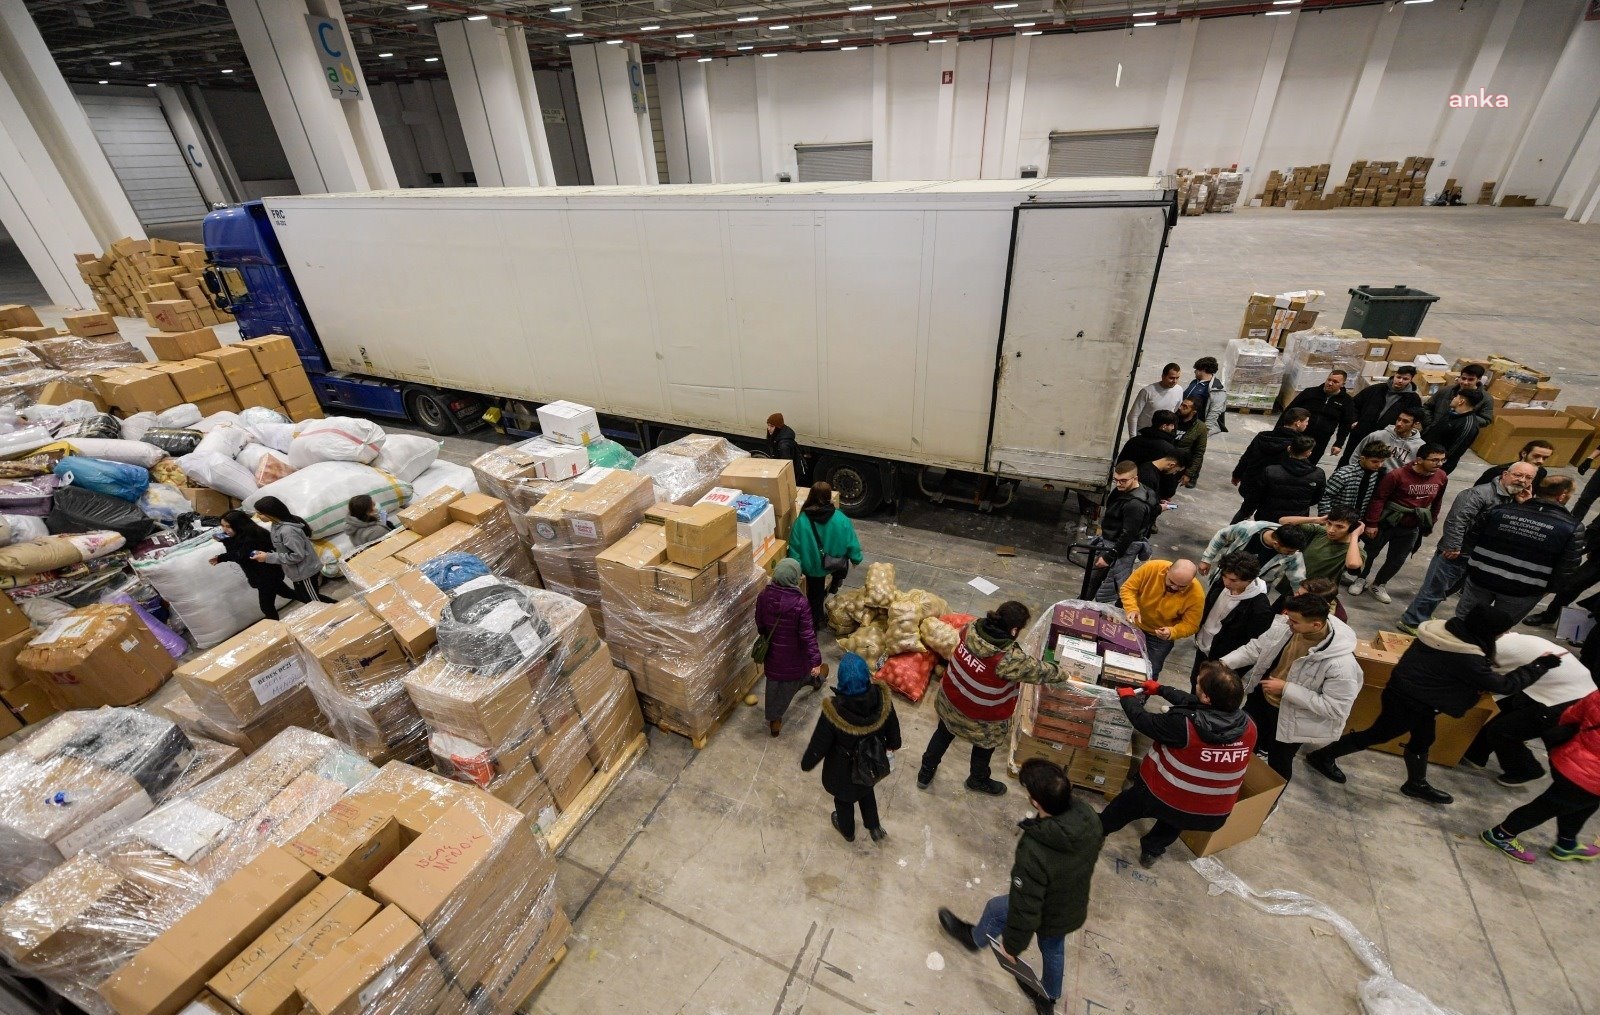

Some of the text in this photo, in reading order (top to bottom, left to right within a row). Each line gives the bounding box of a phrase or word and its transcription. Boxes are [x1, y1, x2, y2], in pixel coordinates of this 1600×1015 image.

[318, 22, 341, 58] C
[327, 62, 356, 86] a b
[631, 65, 640, 87] C
[187, 144, 202, 168] C
[1388, 445, 1411, 462] AVI
[705, 493, 730, 503] HYPO
[1408, 483, 1440, 495] NIKE
[958, 643, 986, 673] STAFF
[1200, 749, 1250, 763] STAFF
